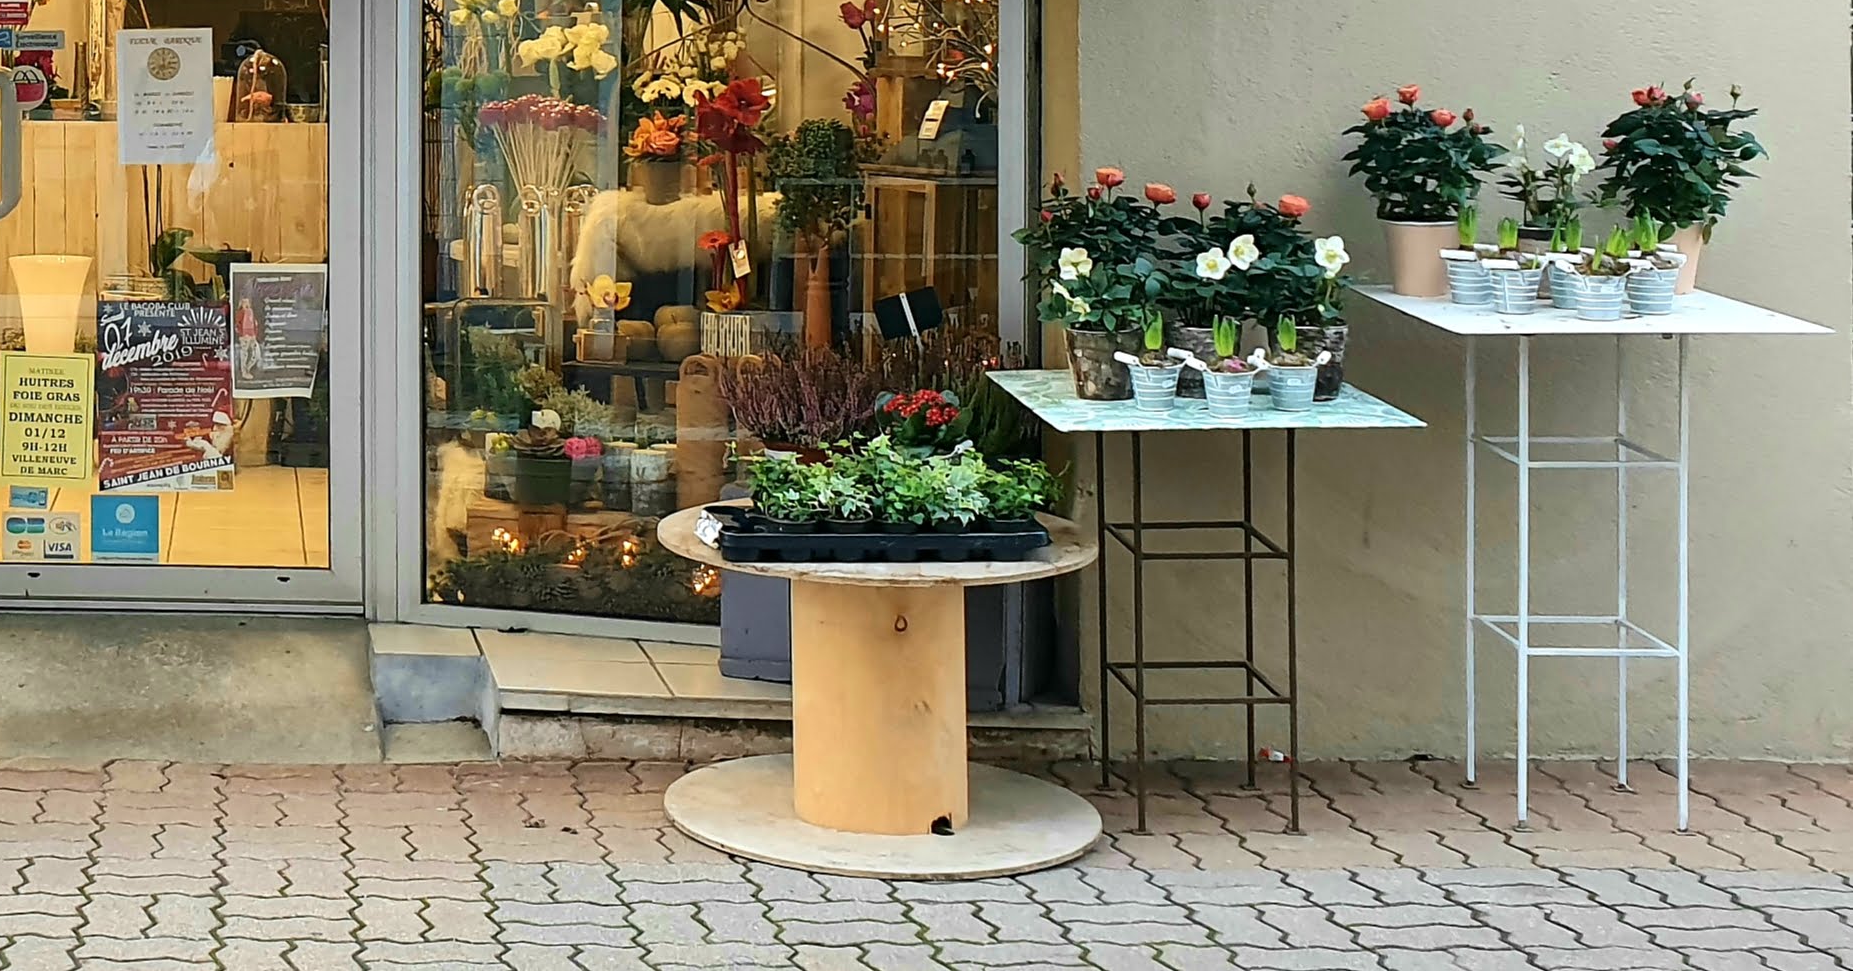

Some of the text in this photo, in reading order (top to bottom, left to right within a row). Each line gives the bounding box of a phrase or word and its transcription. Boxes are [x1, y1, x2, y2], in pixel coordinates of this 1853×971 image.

[151, 346, 193, 367] 2019
[19, 377, 75, 388] HUITRES
[13, 390, 81, 402] FOIE GRAS
[8, 412, 83, 425] DIMANCHE
[24, 428, 66, 439] 01/12
[22, 442, 67, 453] 9H-12H
[12, 454, 77, 465] VILLENEUVE
[20, 466, 68, 476] DE MARC
[103, 474, 135, 488] SAINT
[137, 468, 163, 481] JEAN
[166, 465, 180, 476] DE
[182, 456, 232, 471] BOURNAY
[48, 542, 72, 552] VISA
